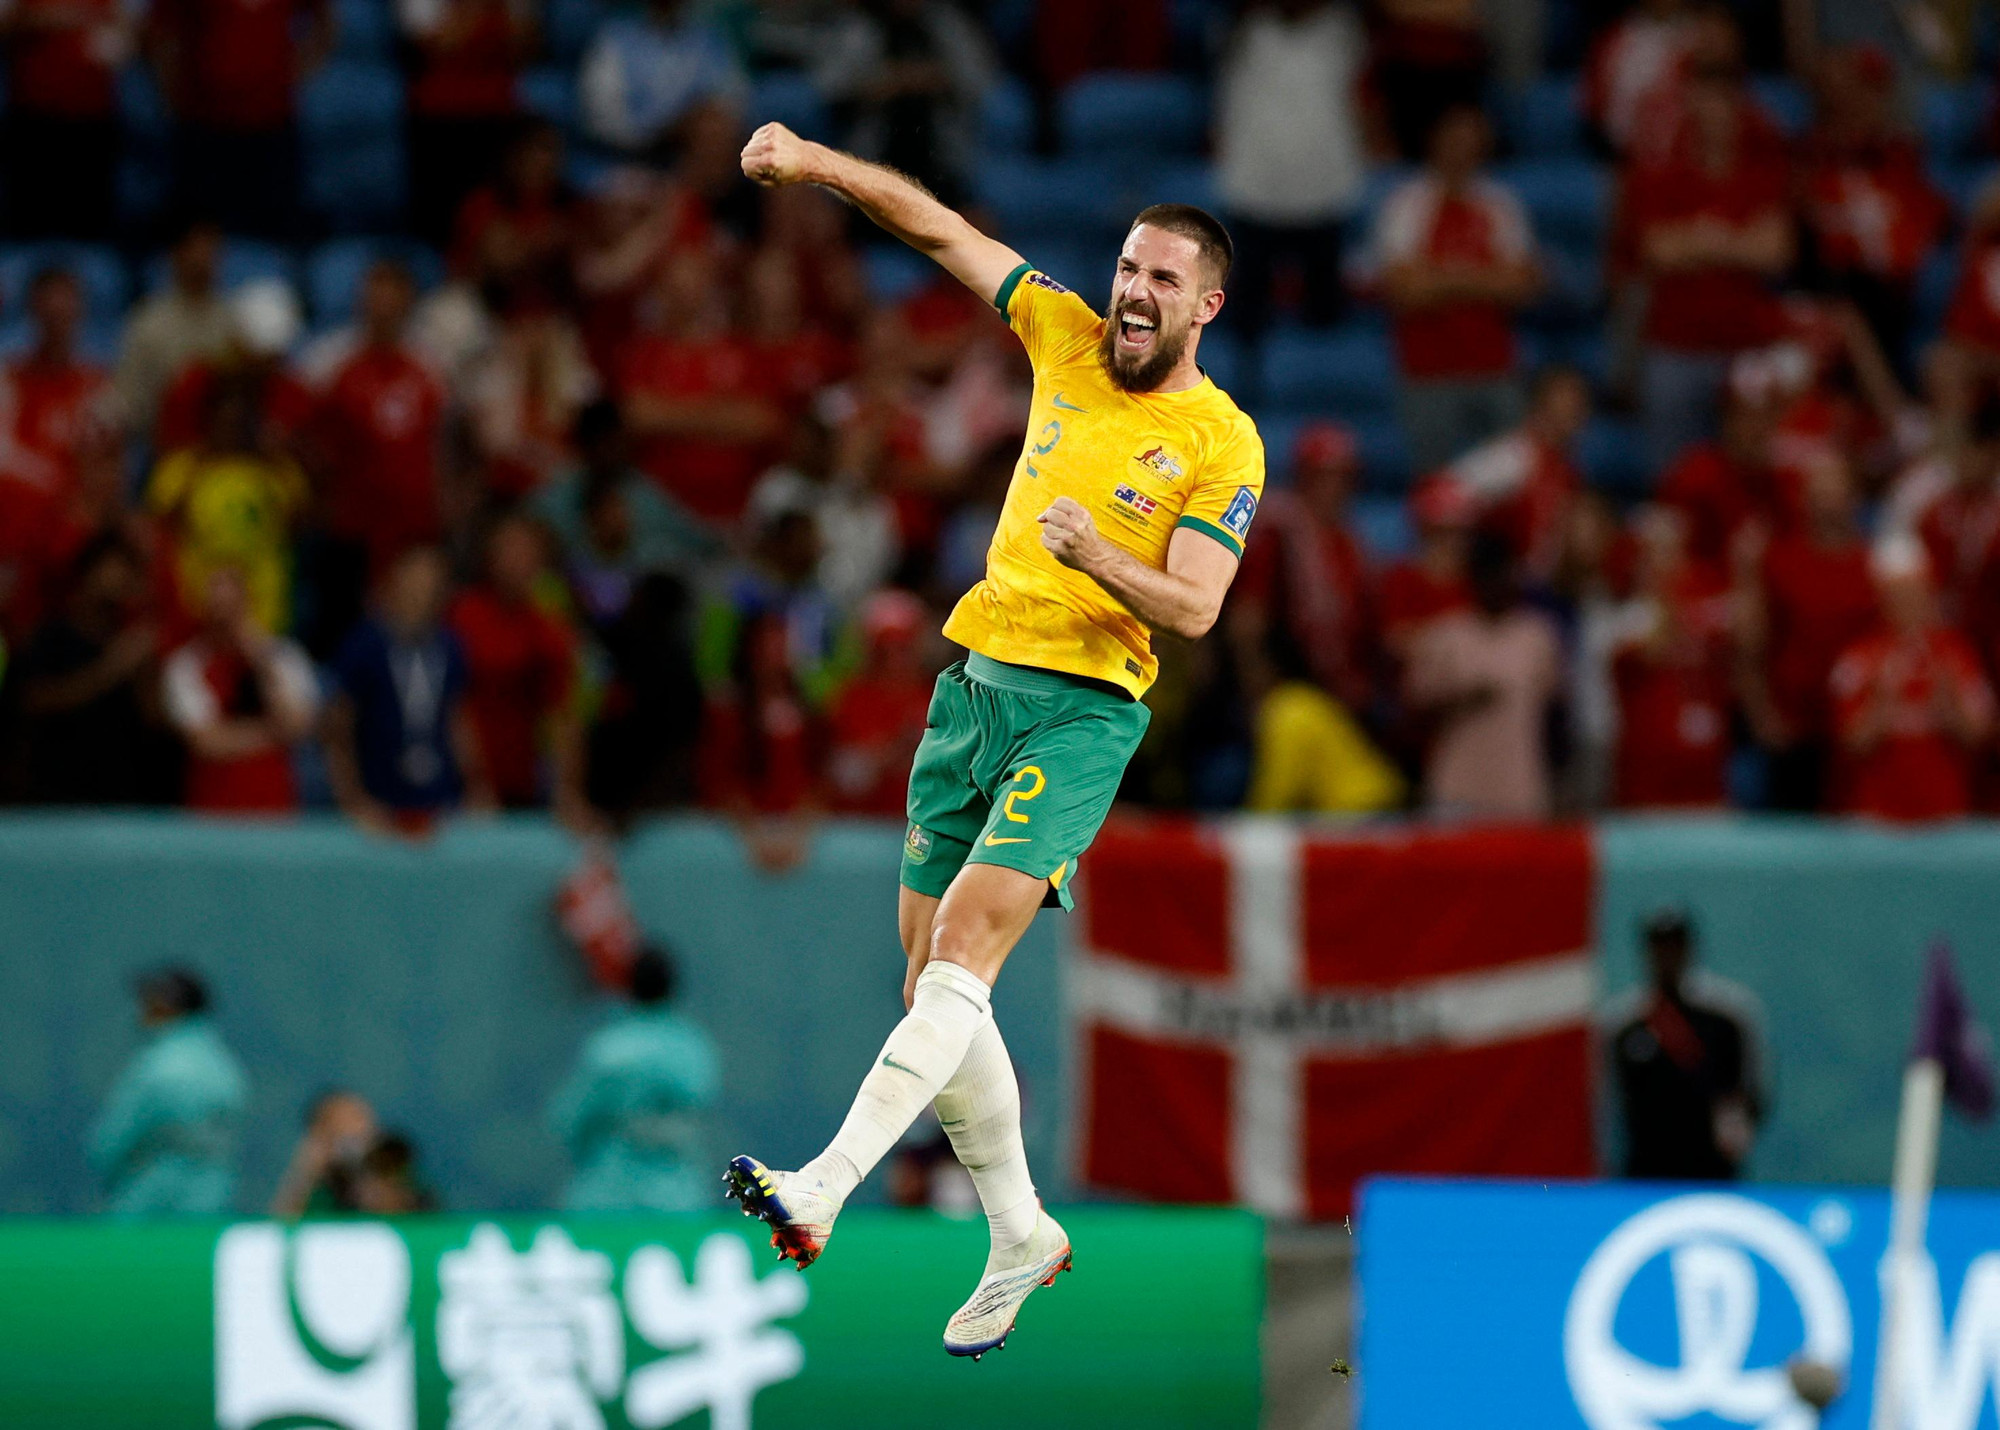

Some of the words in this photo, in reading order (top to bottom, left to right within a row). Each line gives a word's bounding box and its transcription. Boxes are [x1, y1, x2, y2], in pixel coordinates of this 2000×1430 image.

[1026, 420, 1061, 478] 2
[1137, 463, 1168, 486] AUSTRALIA
[1003, 765, 1047, 824] 2
[437, 1223, 808, 1430] 蒙牛
